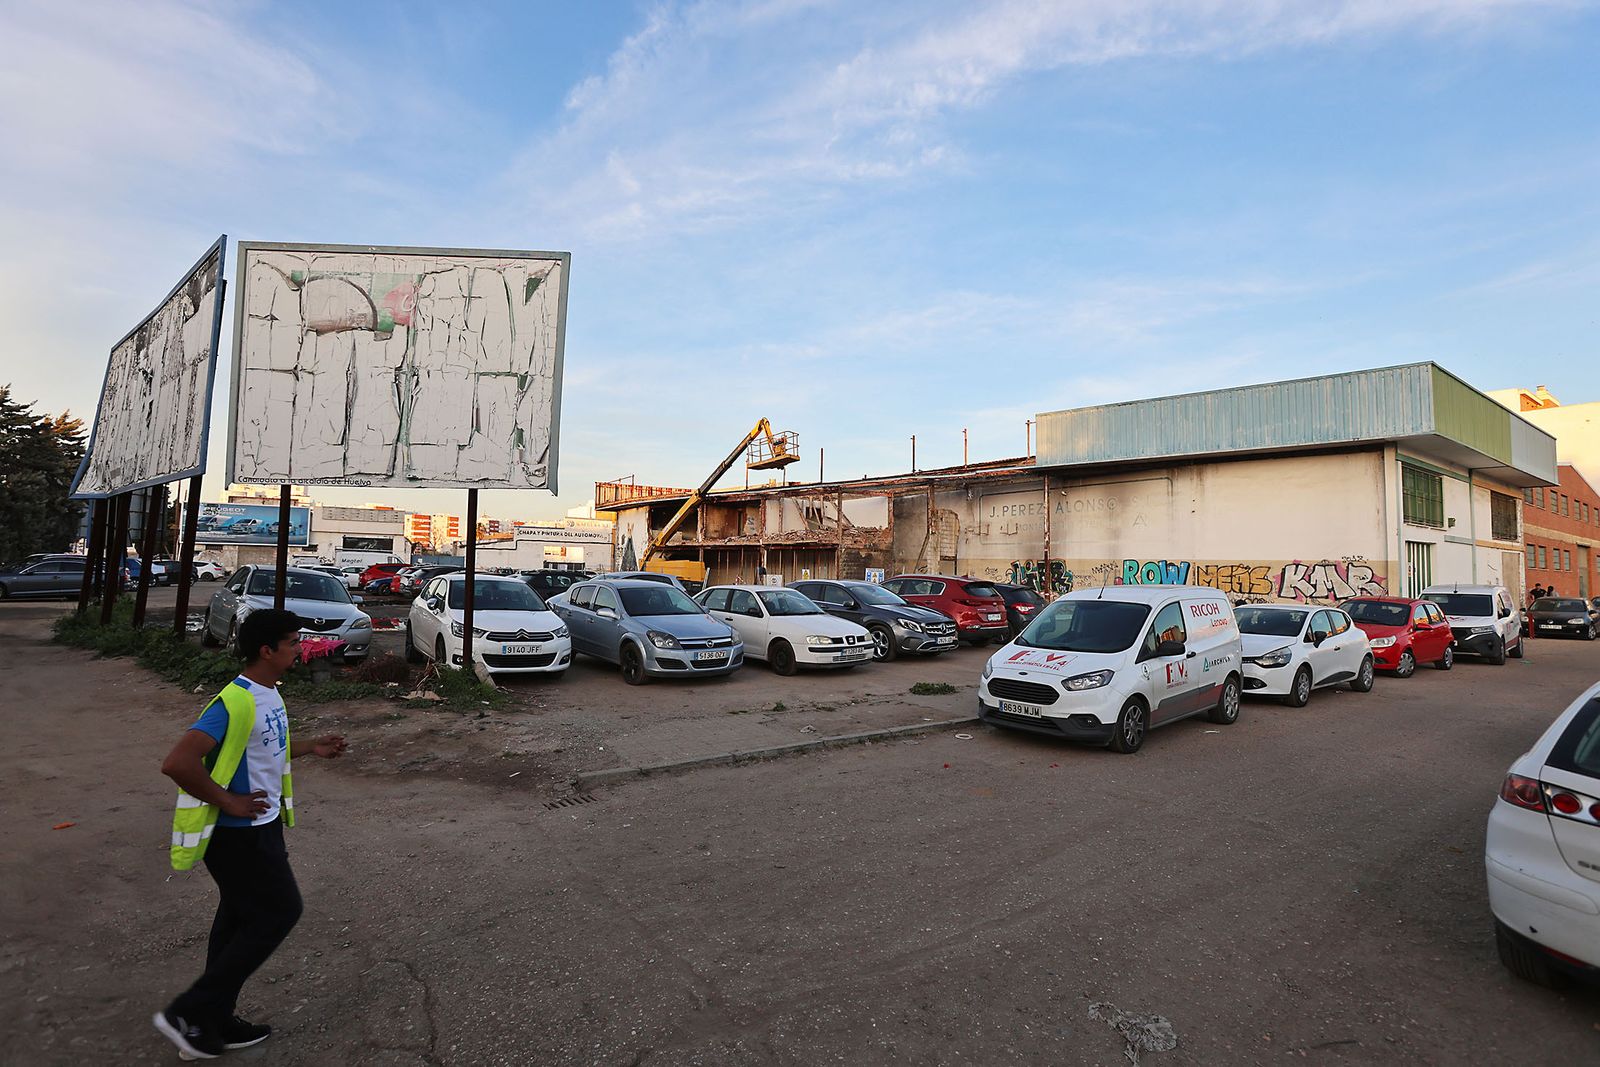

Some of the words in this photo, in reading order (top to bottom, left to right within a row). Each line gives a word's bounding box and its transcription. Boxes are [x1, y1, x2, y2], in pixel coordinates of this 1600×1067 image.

[343, 477, 372, 486] Huelva
[1055, 497, 1118, 515] ALONSO
[1122, 559, 1189, 586] ROW
[1189, 602, 1221, 618] RICOH
[507, 646, 526, 654] 9140
[1003, 702, 1022, 714] 8639
[1023, 706, 1040, 717] MJM
